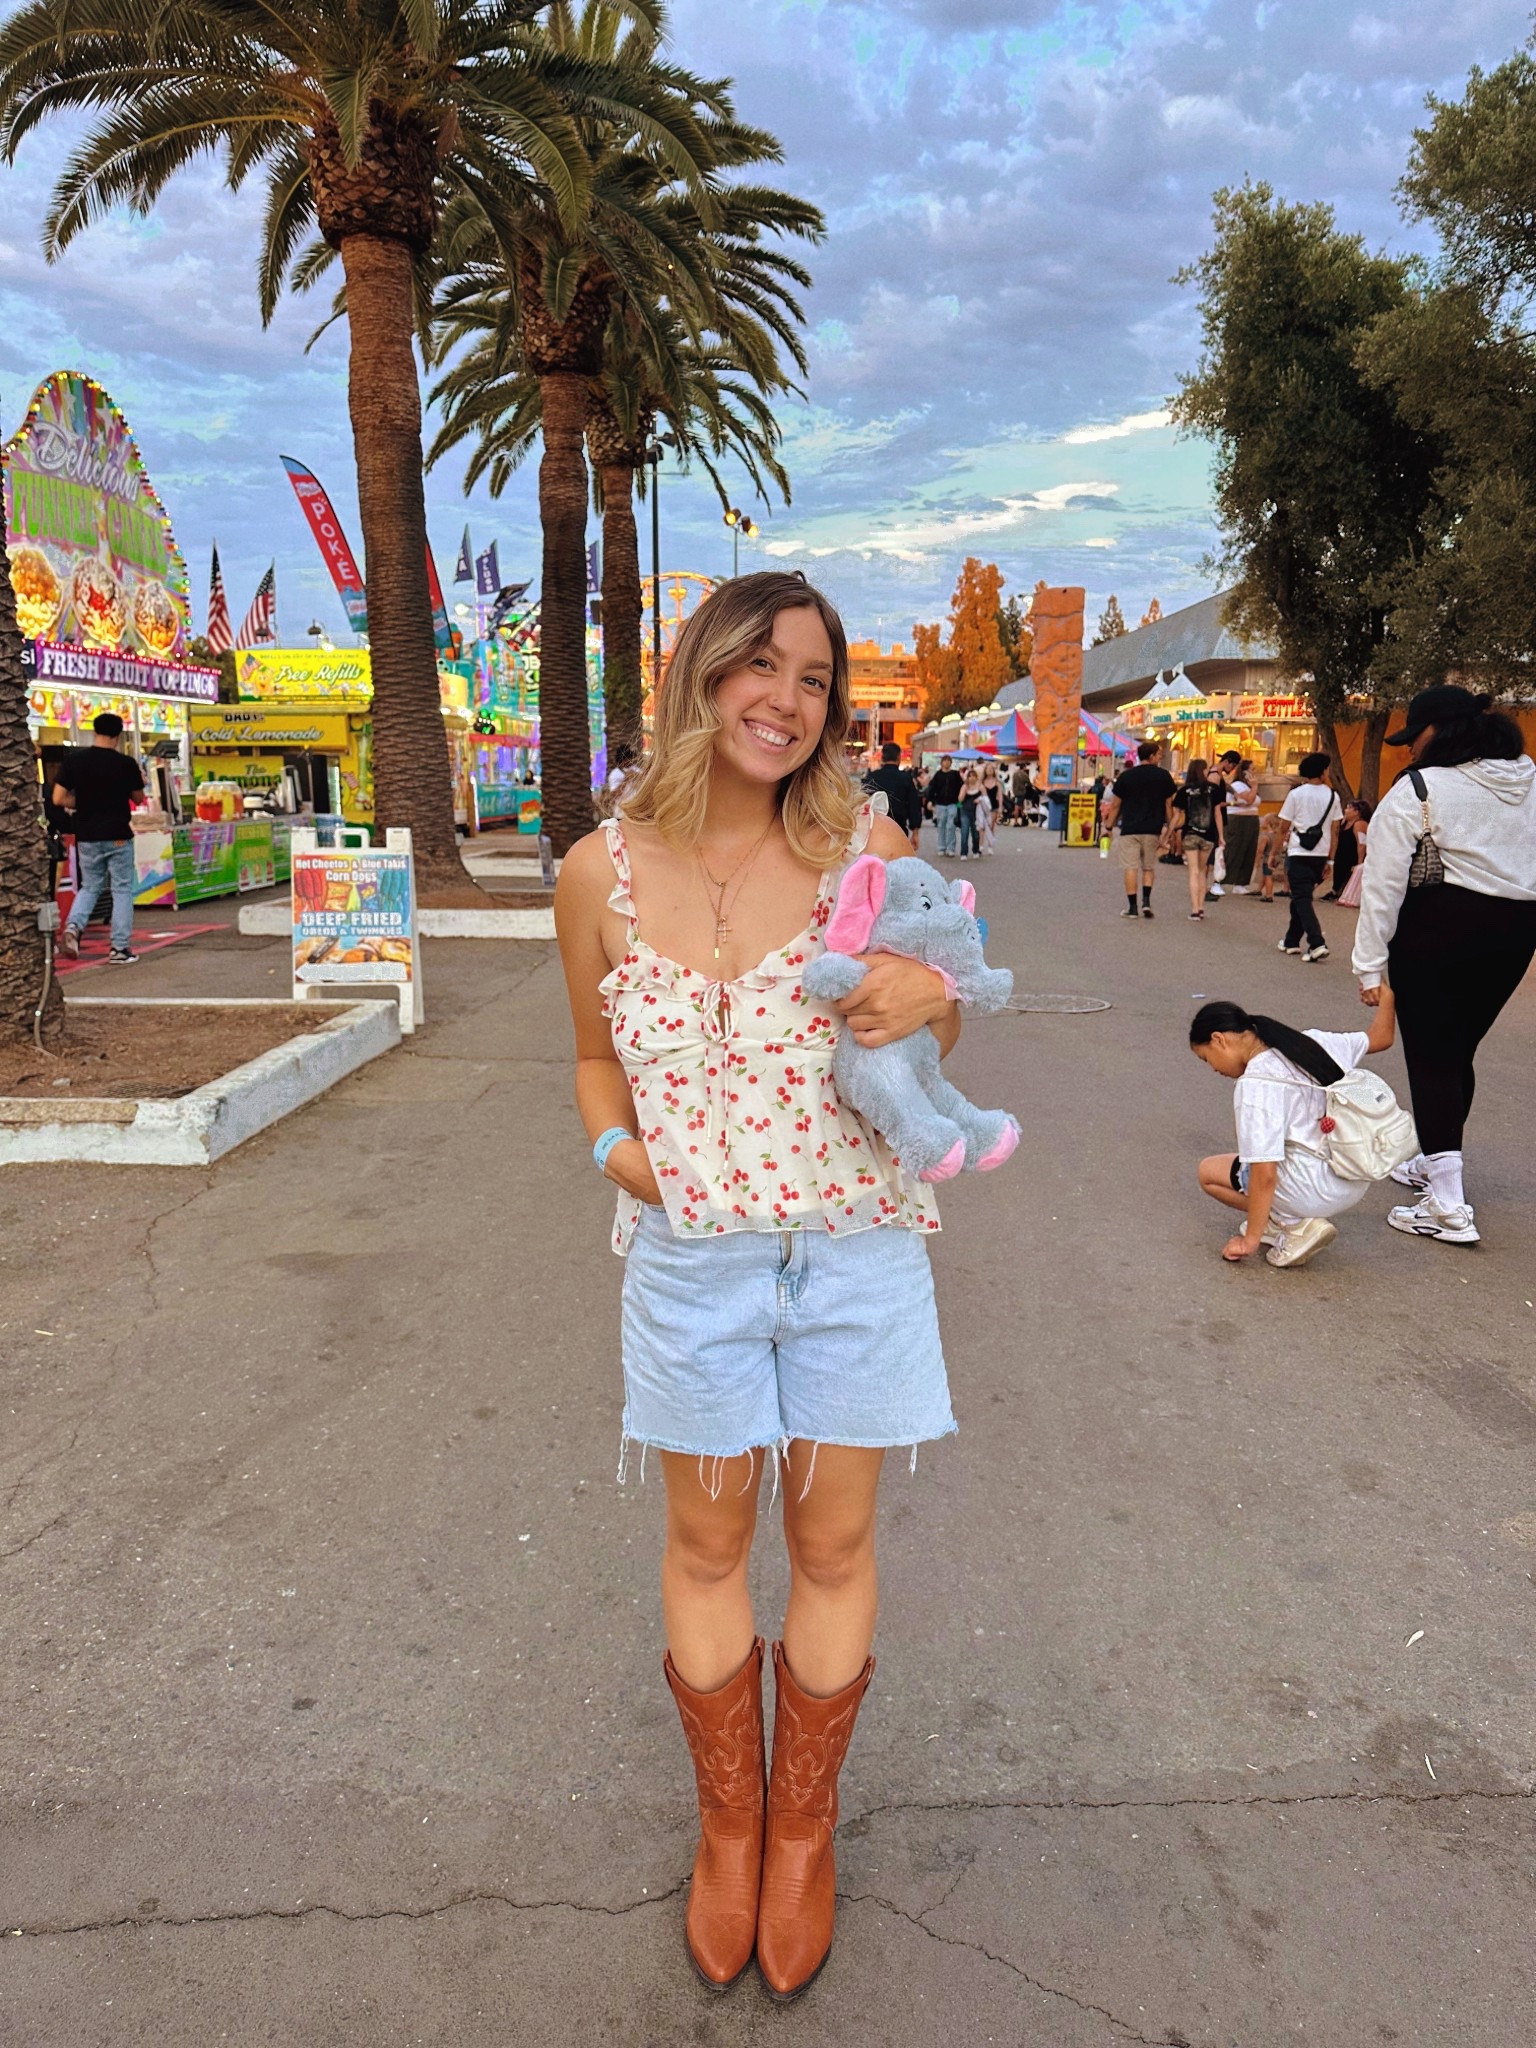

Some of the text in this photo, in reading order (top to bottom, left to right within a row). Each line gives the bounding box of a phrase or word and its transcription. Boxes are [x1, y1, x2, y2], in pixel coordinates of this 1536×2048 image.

[42, 649, 217, 696] FRESH FRUIT TOPPINGS
[274, 663, 365, 685] Free Refills
[1263, 698, 1304, 717] KETTLE
[201, 727, 234, 742] Cold
[237, 726, 322, 742] Lemonade
[296, 859, 407, 869] Hot Cheetos & Blue Takis
[325, 870, 377, 883] Corn Dogs
[302, 911, 402, 926] DEEP FRIED
[351, 926, 403, 936] TWINKIES
